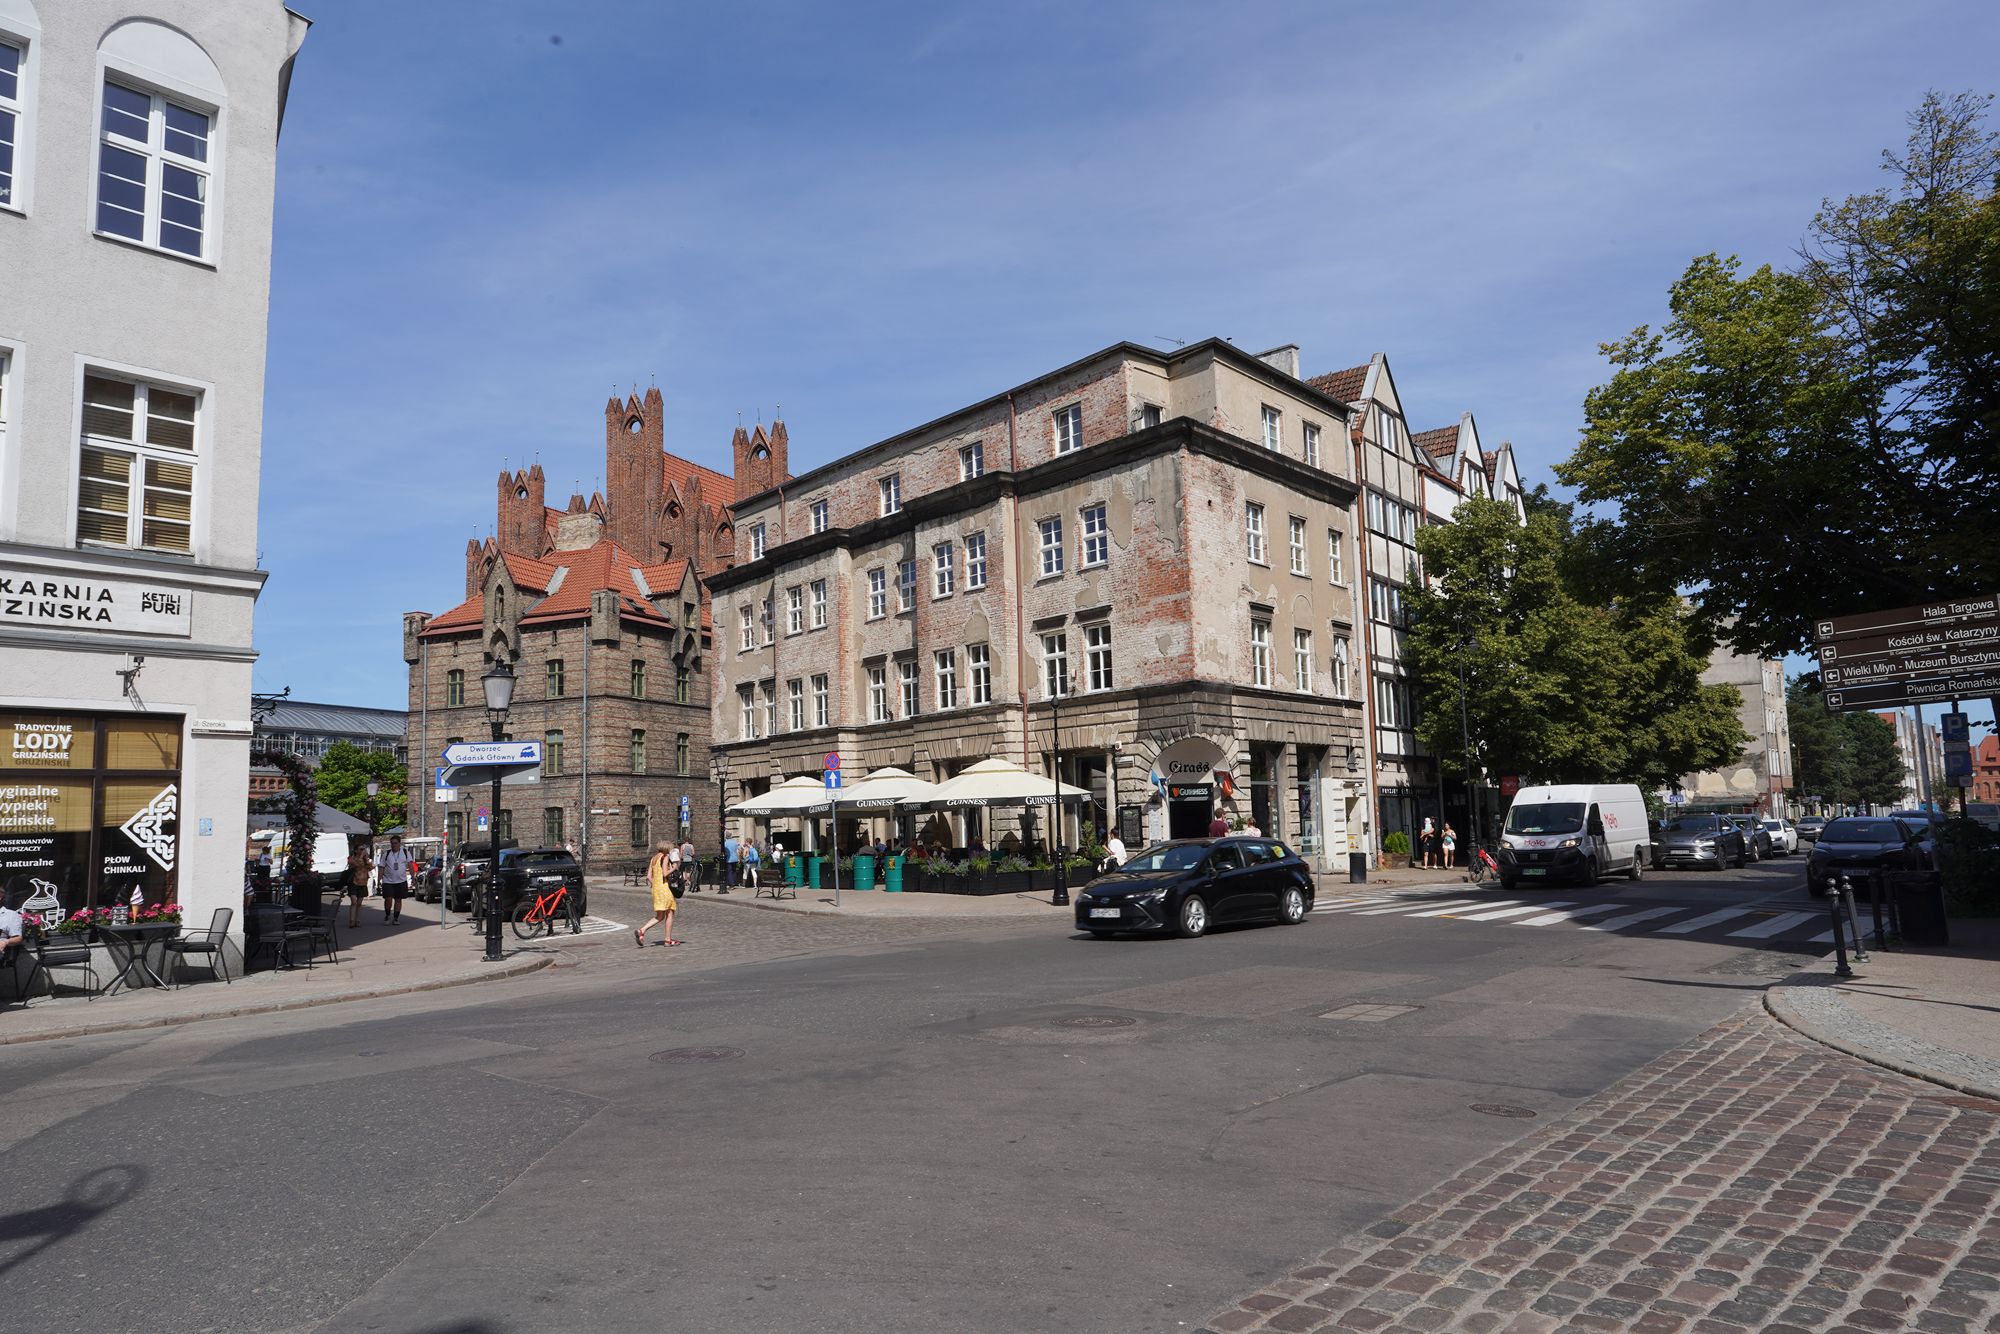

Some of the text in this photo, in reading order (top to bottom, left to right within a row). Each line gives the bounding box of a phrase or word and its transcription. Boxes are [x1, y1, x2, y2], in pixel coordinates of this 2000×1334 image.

[0, 578, 114, 603] KARNIA
[0, 599, 112, 622] ZIŃSKA
[1922, 600, 1994, 618] Hala Targowa
[1888, 626, 1998, 648] Kościół św. Katarzyny
[1843, 665, 1871, 677] Wielki
[1873, 664, 1896, 675] Młyn
[1904, 658, 1947, 670] Muzeum
[1950, 652, 2000, 665] Bursztynu
[1906, 682, 1946, 694] Piwnica
[14, 724, 72, 732] TRADYCYJNE
[13, 733, 73, 749] LODY
[12, 750, 69, 759] GRUZIŃSKIE
[1169, 760, 1210, 773] Grass
[0, 785, 59, 798] yginalne
[1179, 788, 1208, 796] GUINNESS
[856, 799, 896, 808] GUINNESS
[947, 798, 988, 806] GUINNESS
[808, 804, 830, 813] GUINNESS
[5, 859, 54, 867] naturalne
[104, 856, 131, 864] PŁOW
[104, 865, 146, 874] CHINKALI
